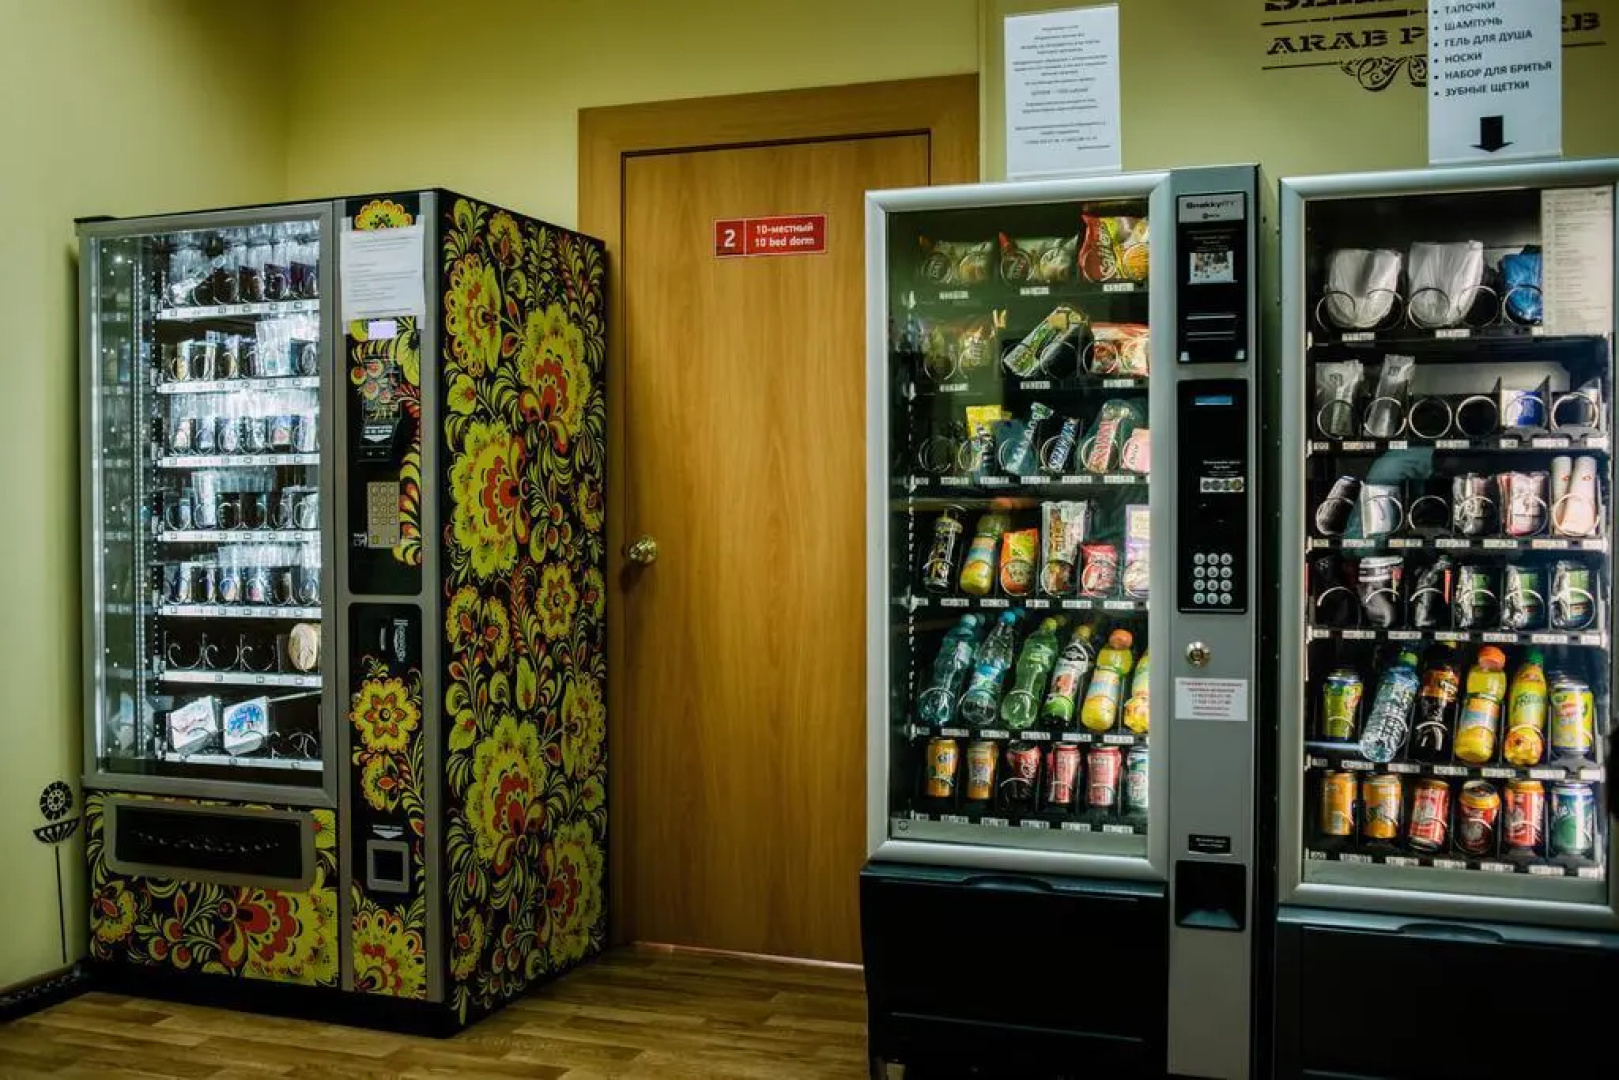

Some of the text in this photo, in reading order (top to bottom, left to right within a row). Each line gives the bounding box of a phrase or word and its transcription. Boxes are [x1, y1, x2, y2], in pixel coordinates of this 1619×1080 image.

[1444, 1, 1496, 14] ТАПОЧКИ
[1444, 17, 1503, 31] ШАМПУНЬ
[1266, 29, 1389, 55] ARAB
[1444, 29, 1533, 47] ГЕЛЬ ДЛЯ ДУША
[1444, 52, 1483, 64] НОСКИ
[1444, 61, 1552, 80] НАБОР ДЛЯ БРИТЬЯ
[1444, 80, 1530, 97] ЗУБНЫЕ ЩЕТКИ
[755, 222, 814, 235] 10-местный
[723, 228, 736, 248] 2
[754, 236, 815, 248] 10 bed dorm
